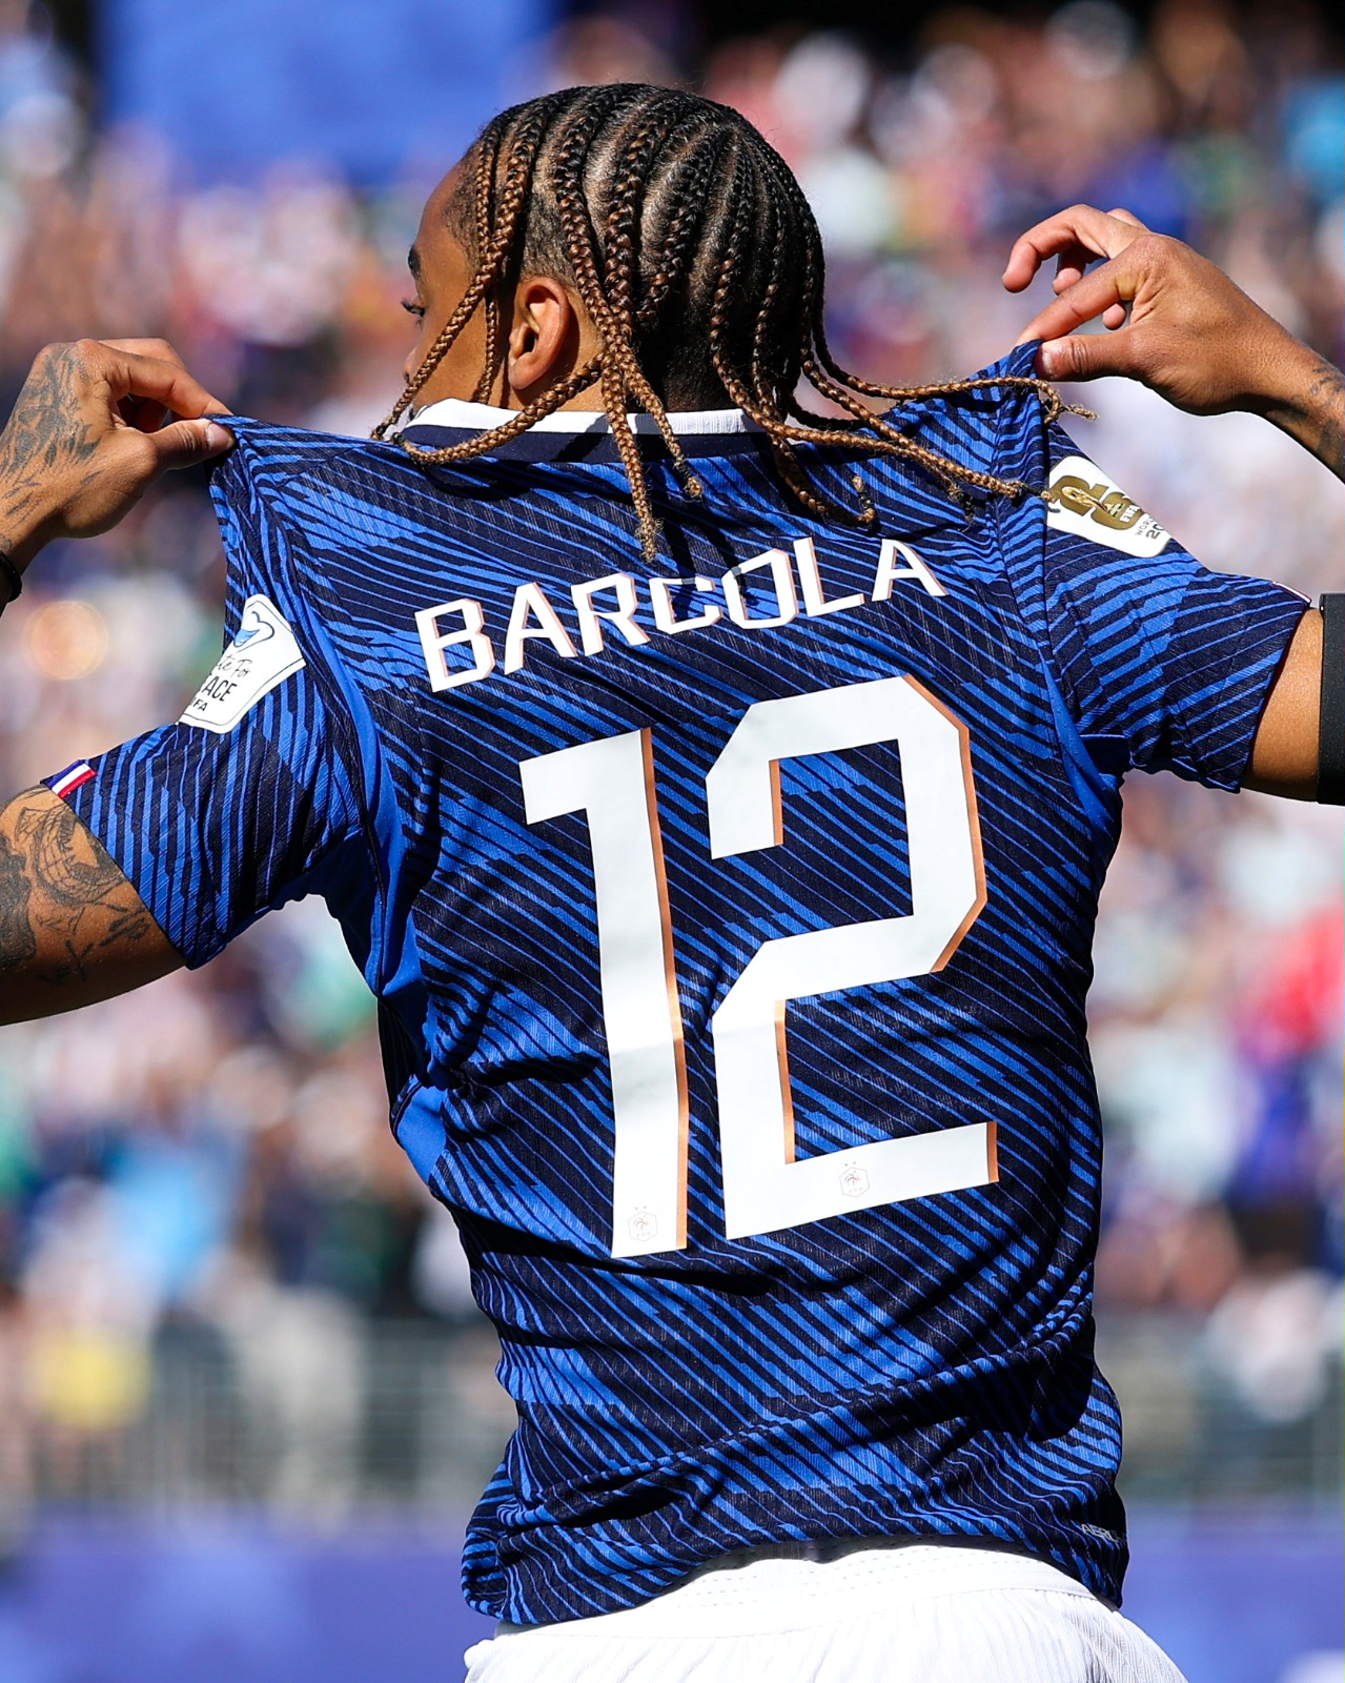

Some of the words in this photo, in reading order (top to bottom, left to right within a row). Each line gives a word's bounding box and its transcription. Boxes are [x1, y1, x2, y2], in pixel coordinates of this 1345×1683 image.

[201, 675, 238, 702] ACE
[414, 537, 948, 693] BARCOLA
[519, 674, 999, 1258] 12
